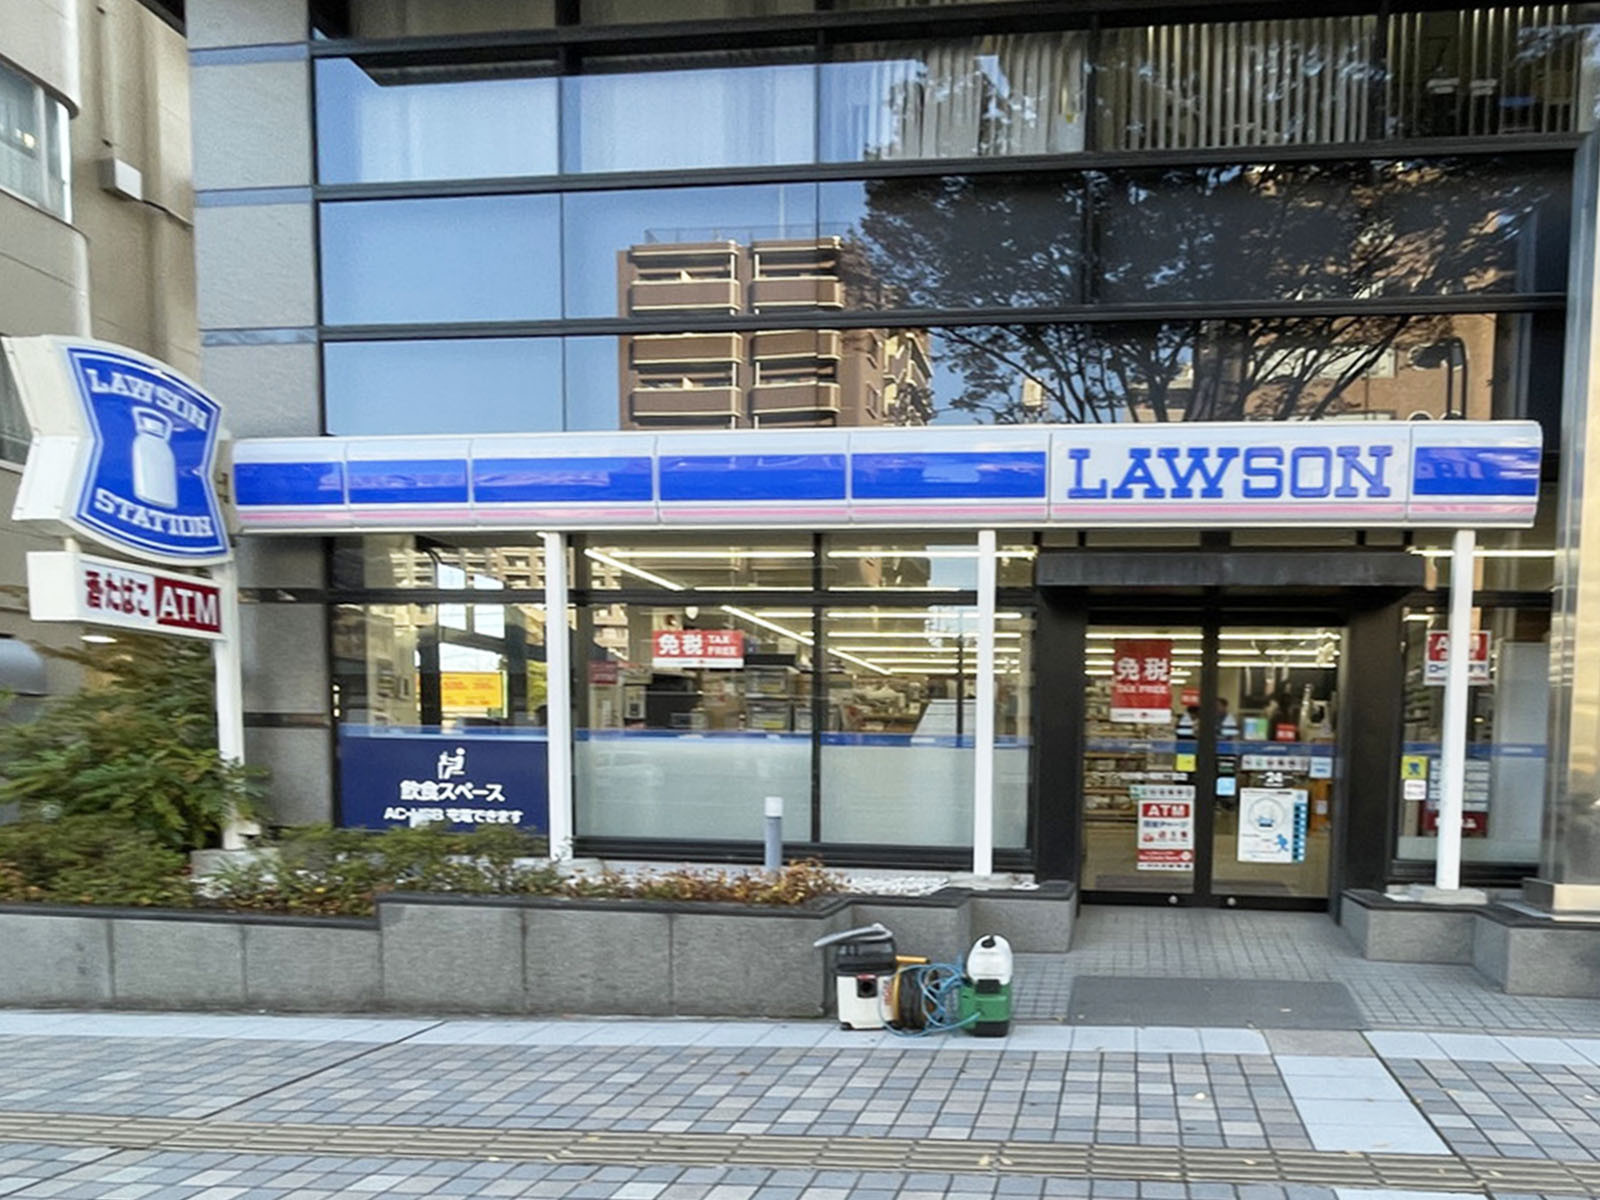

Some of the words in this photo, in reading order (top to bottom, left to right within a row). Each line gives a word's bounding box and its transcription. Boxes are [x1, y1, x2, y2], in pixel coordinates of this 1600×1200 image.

[86, 368, 209, 431] LAWSON
[1067, 446, 1393, 499] LAWSON
[94, 487, 214, 537] STATION
[158, 586, 218, 625] ATM
[658, 633, 703, 656] 免税
[707, 634, 730, 645] TAX
[707, 645, 737, 656] FREE
[1117, 657, 1168, 681] 免税
[1138, 684, 1168, 694] FREE
[400, 780, 506, 802] 飲食スペース
[1147, 804, 1186, 817] ATM
